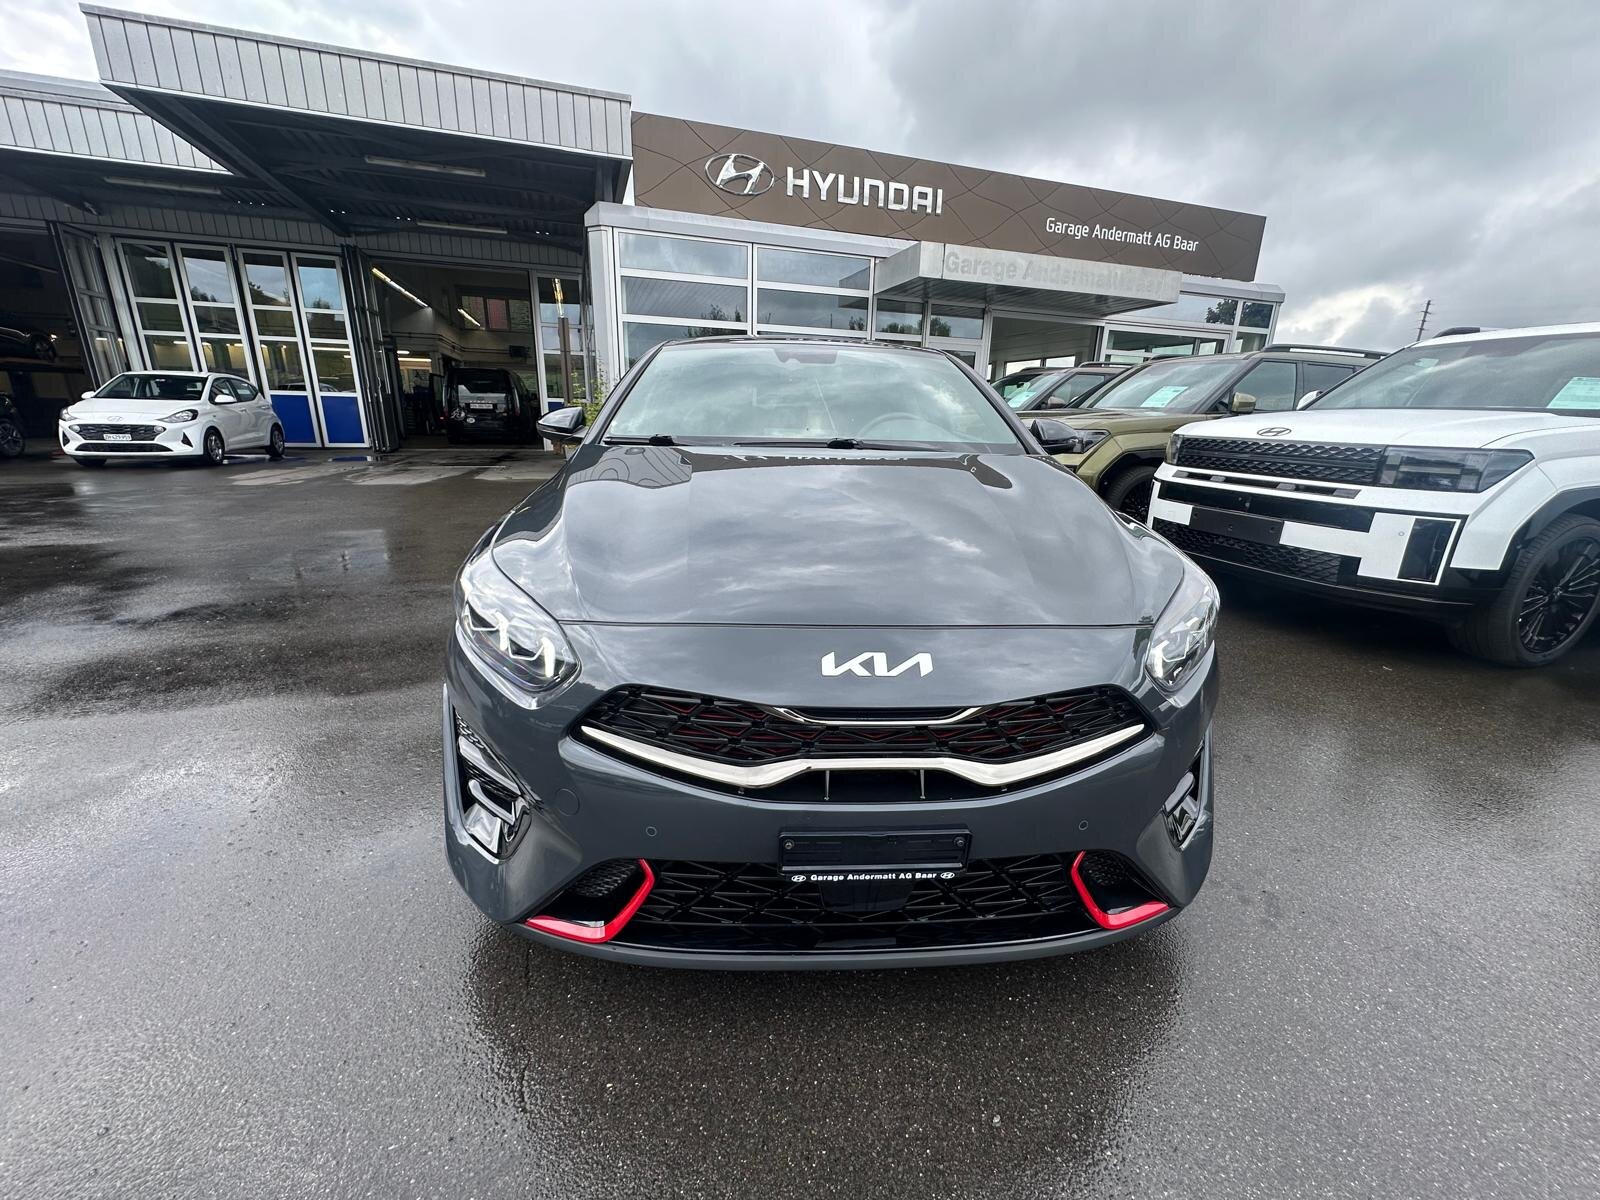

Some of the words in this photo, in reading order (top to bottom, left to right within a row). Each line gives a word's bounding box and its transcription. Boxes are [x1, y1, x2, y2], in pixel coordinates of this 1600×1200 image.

[786, 166, 943, 216] HYUNDAI
[1046, 217, 1089, 239] Garage
[1092, 224, 1152, 246] Andermatt
[1153, 233, 1171, 248] AG
[1173, 235, 1199, 251] Baar
[945, 251, 1017, 282] Garage
[821, 651, 933, 677] KIA
